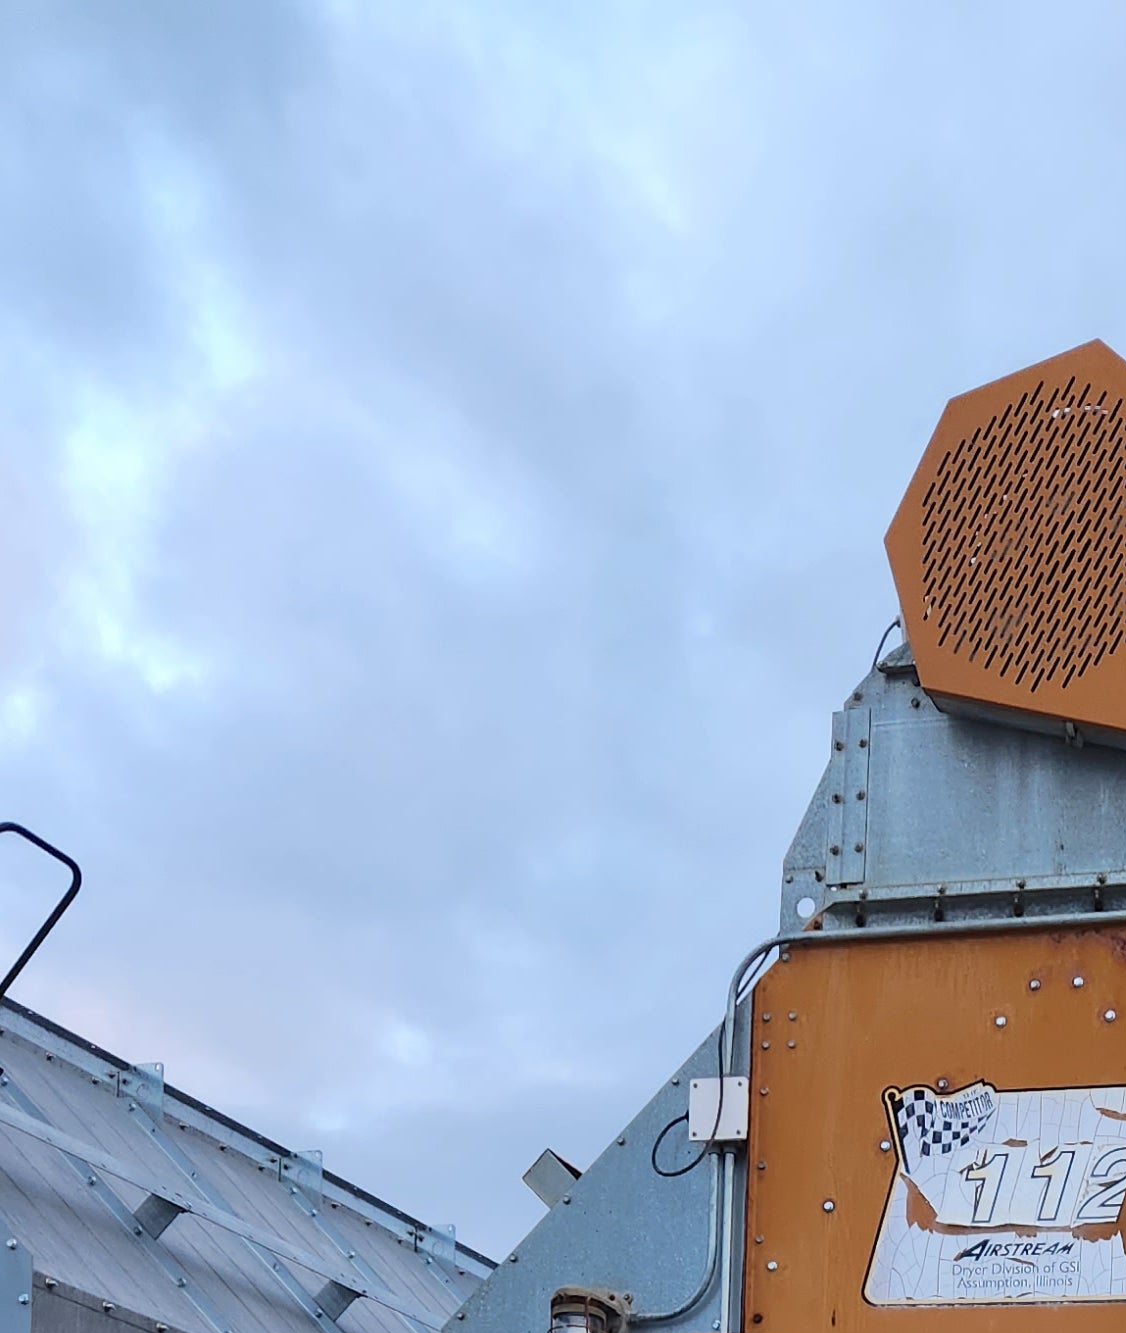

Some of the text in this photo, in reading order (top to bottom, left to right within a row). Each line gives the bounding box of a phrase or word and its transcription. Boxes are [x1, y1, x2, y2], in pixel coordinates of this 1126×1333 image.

[940, 1091, 994, 1120] COMPETITOR
[958, 1239, 1075, 1261] AIRSTREAM
[952, 1260, 1080, 1278] Dryer Division of GSI
[957, 1275, 1073, 1290] Assumption, Illinois
